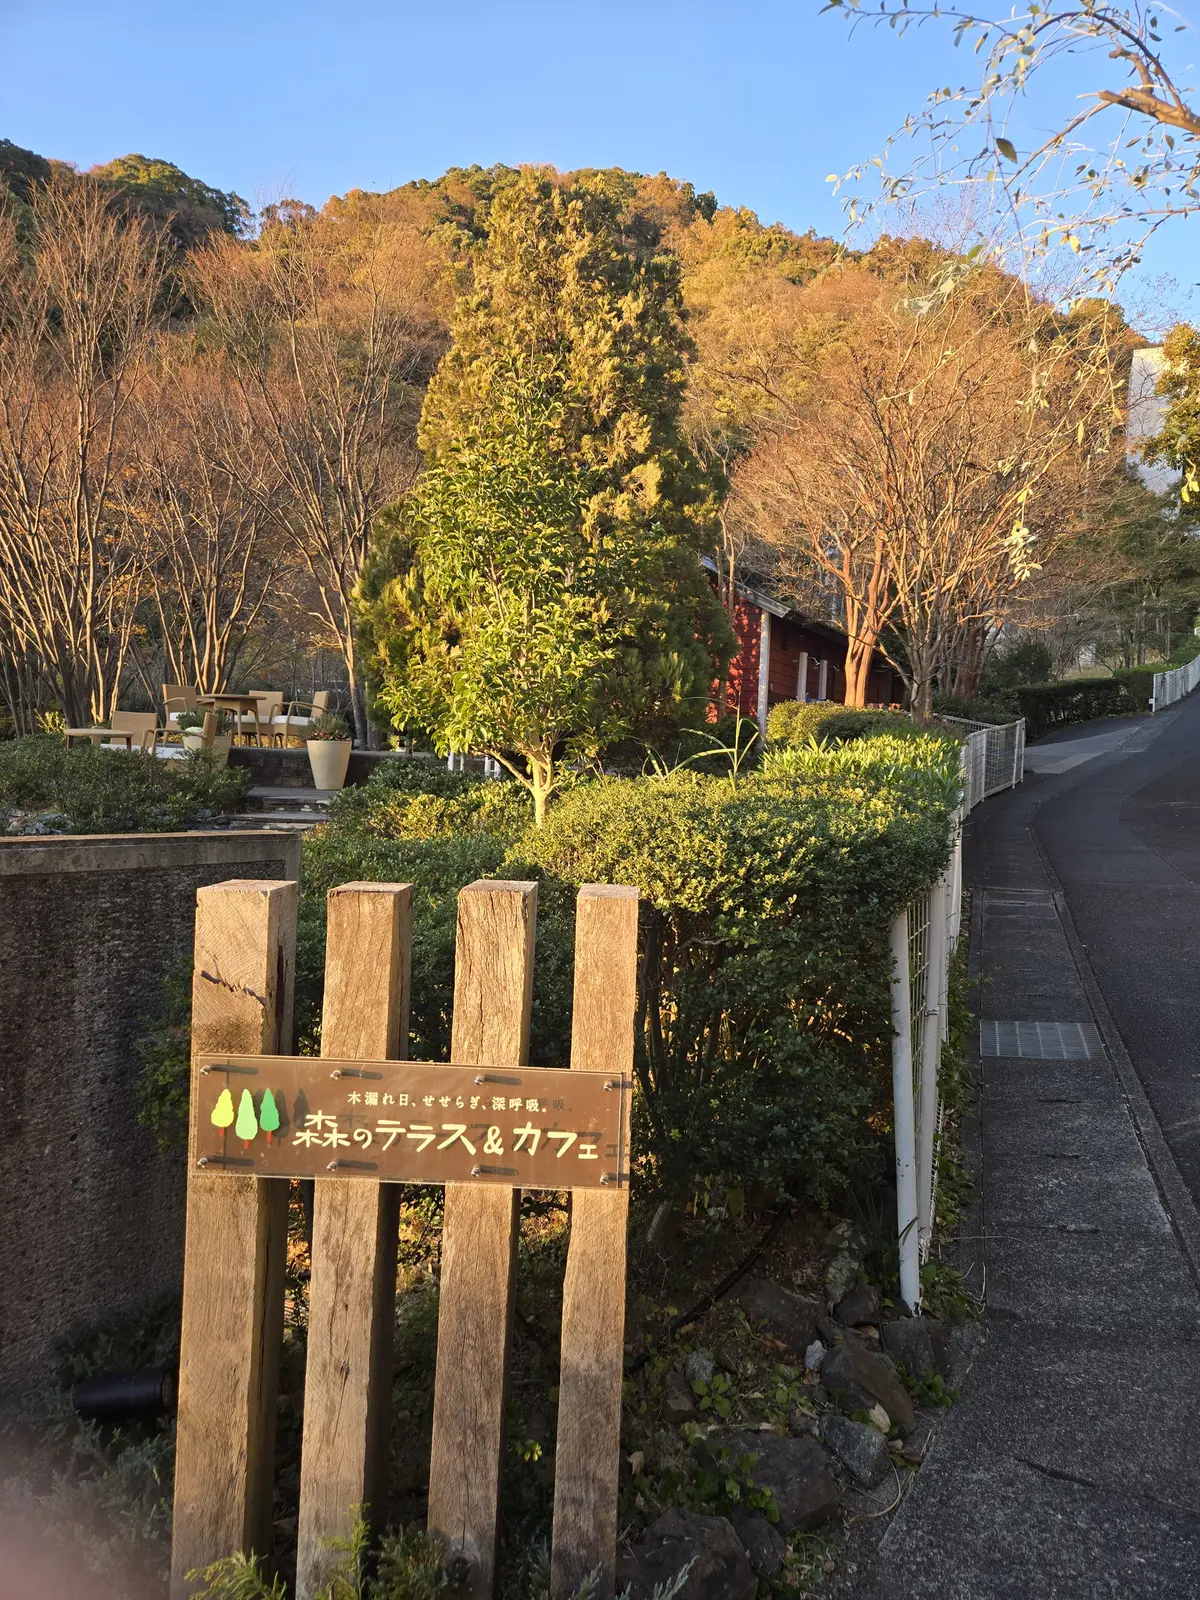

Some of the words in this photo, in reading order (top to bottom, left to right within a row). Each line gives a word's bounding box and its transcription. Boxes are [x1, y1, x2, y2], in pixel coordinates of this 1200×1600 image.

[347, 1091, 548, 1113] 木漏れ日、せせらぎ、深呼吸。
[292, 1110, 599, 1160] 森のテラス&カフェ
